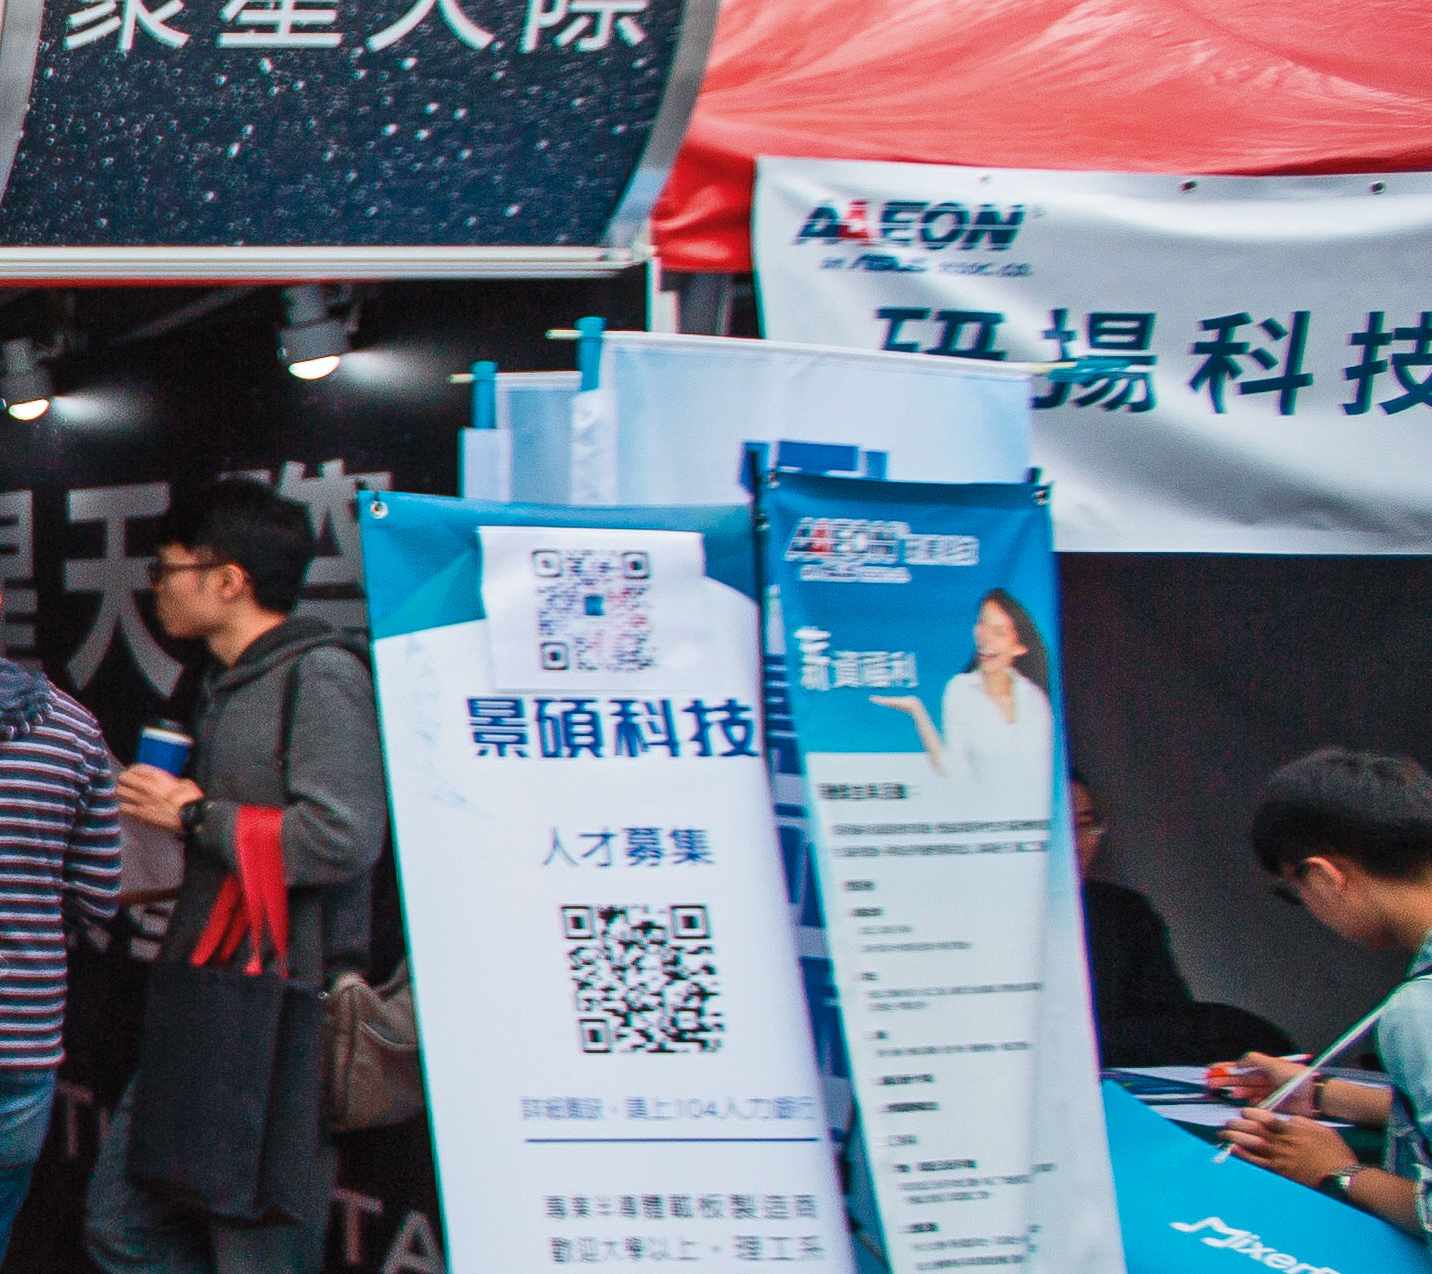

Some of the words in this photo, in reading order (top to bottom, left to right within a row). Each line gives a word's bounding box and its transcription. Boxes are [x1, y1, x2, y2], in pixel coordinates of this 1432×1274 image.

[466, 695, 761, 760] 景碩科技
[541, 826, 715, 867] 人才募集
